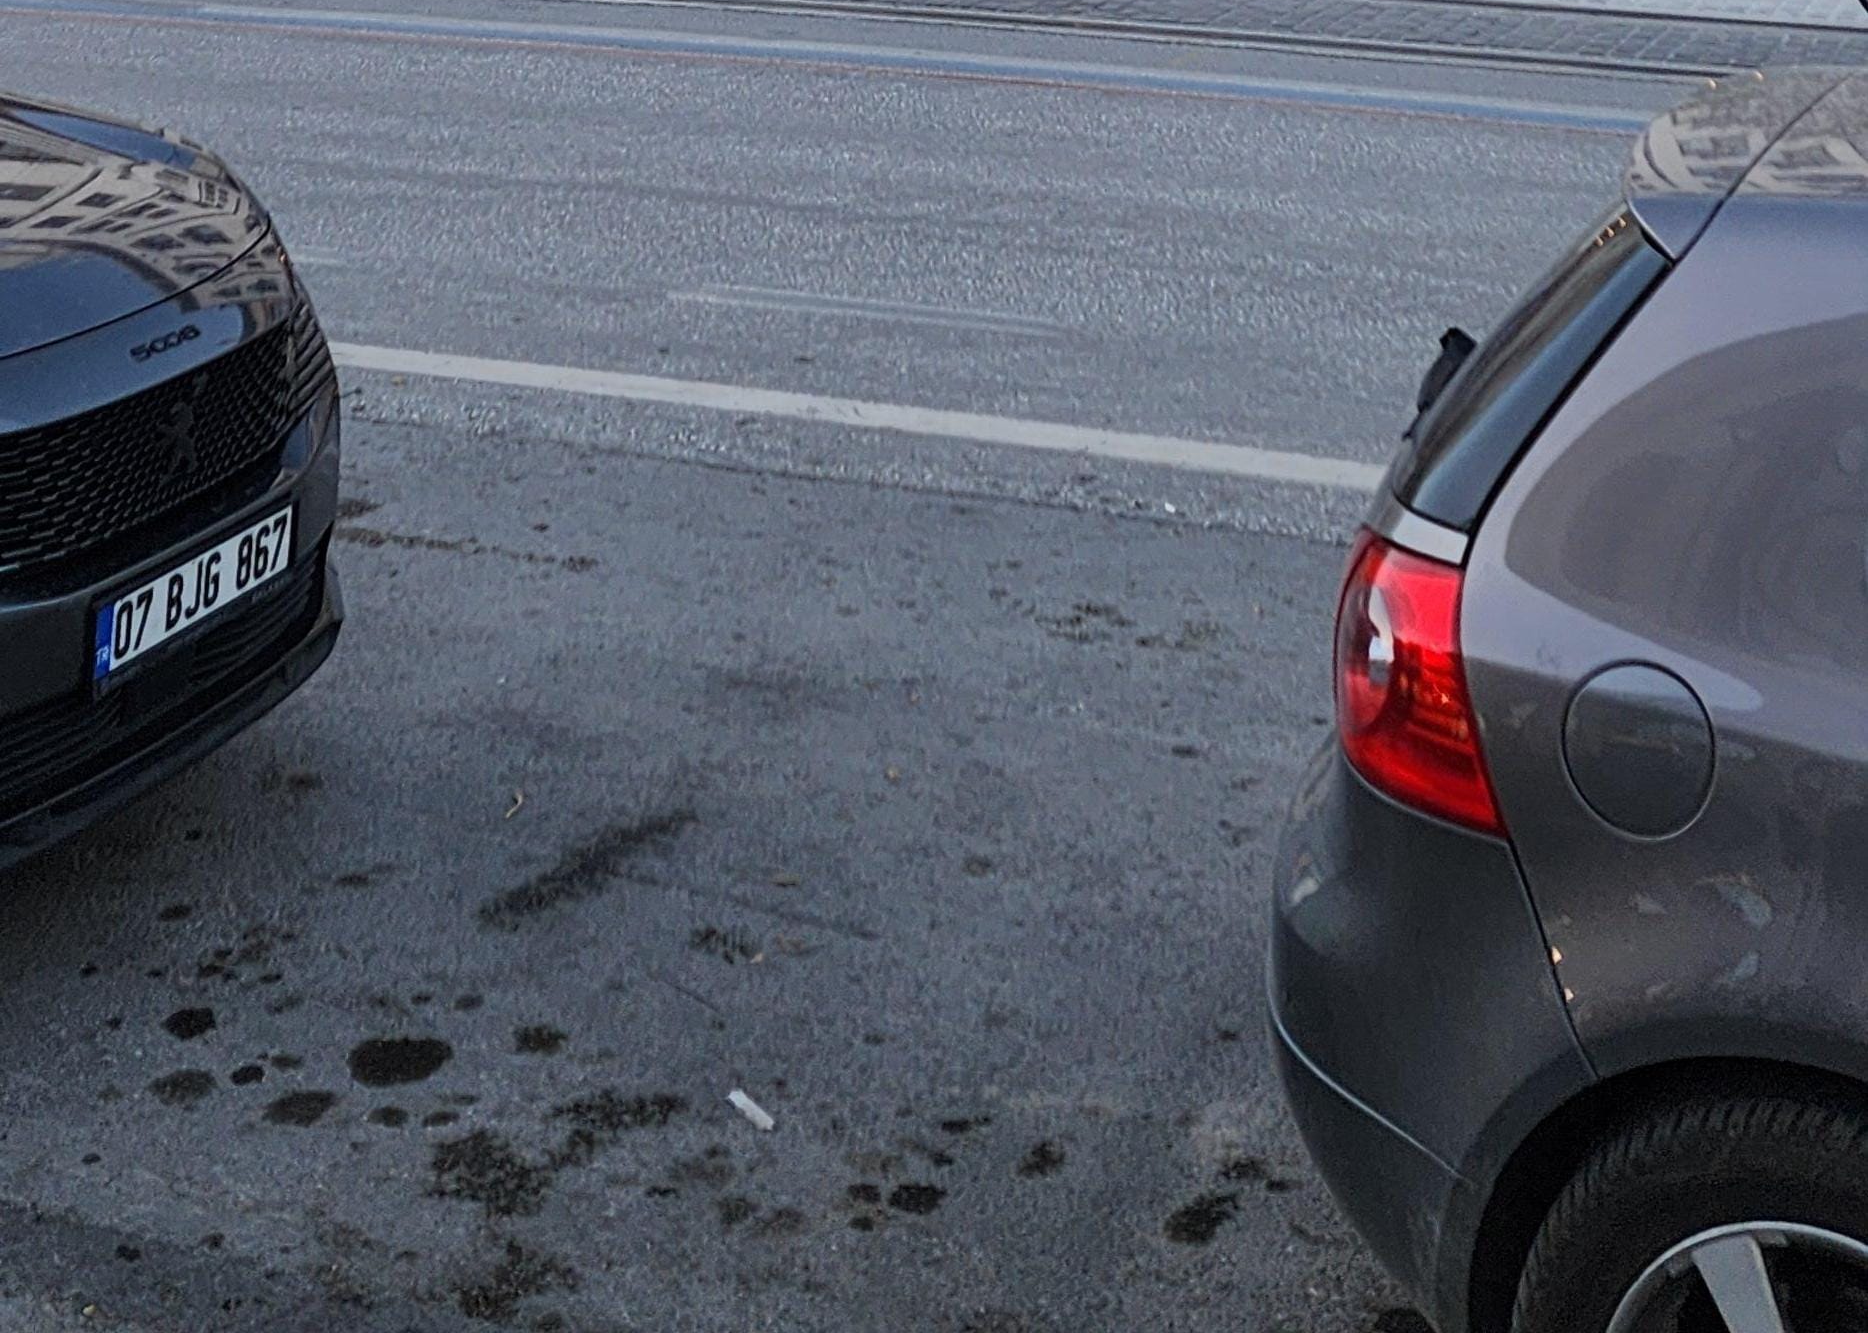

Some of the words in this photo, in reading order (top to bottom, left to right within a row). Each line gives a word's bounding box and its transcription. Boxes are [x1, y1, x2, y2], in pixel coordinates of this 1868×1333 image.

[130, 324, 201, 363] 5008
[114, 587, 153, 660] 07
[165, 551, 221, 632] BJG
[236, 512, 289, 591] 867
